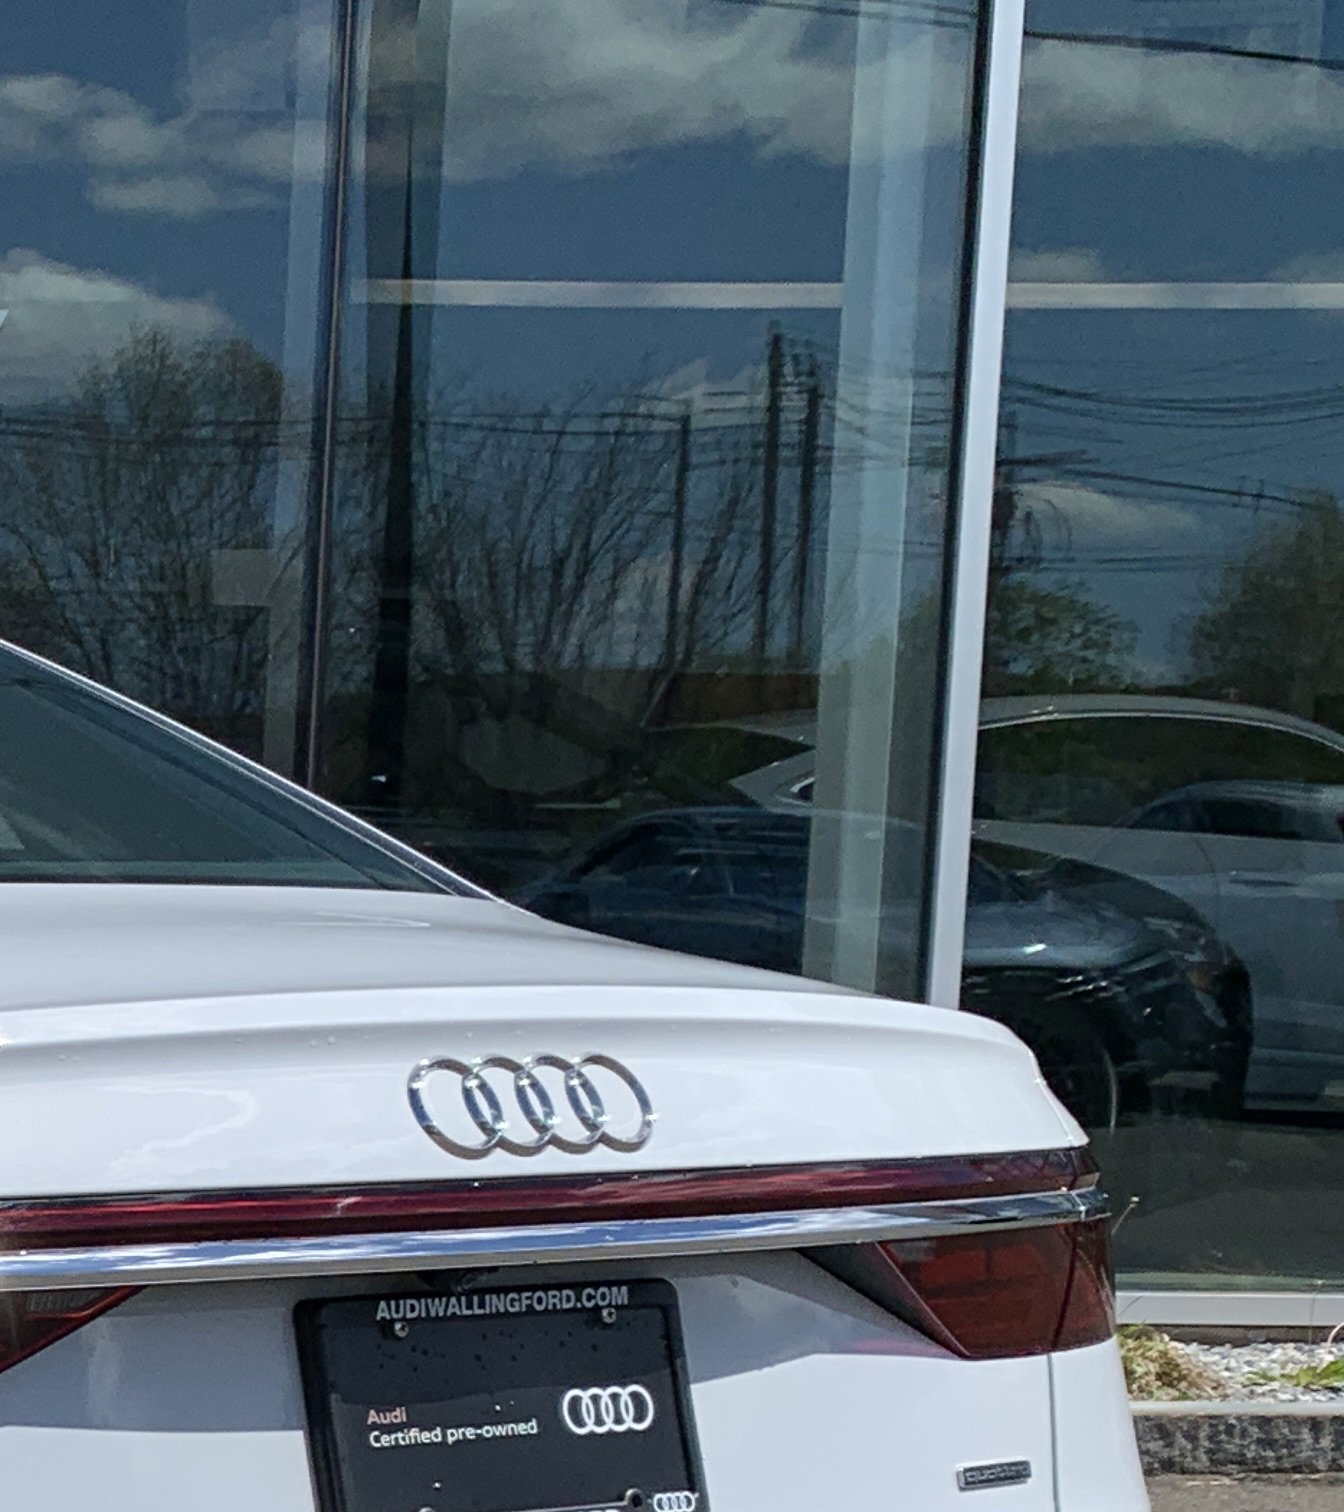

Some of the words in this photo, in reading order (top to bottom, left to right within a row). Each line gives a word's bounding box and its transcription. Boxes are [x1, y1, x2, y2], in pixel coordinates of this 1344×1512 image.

[376, 1286, 629, 1321] AUDIWALLINGFORD.COM
[367, 1407, 407, 1425] Audi
[369, 1427, 443, 1448] Certified
[446, 1418, 538, 1445] pre-owned
